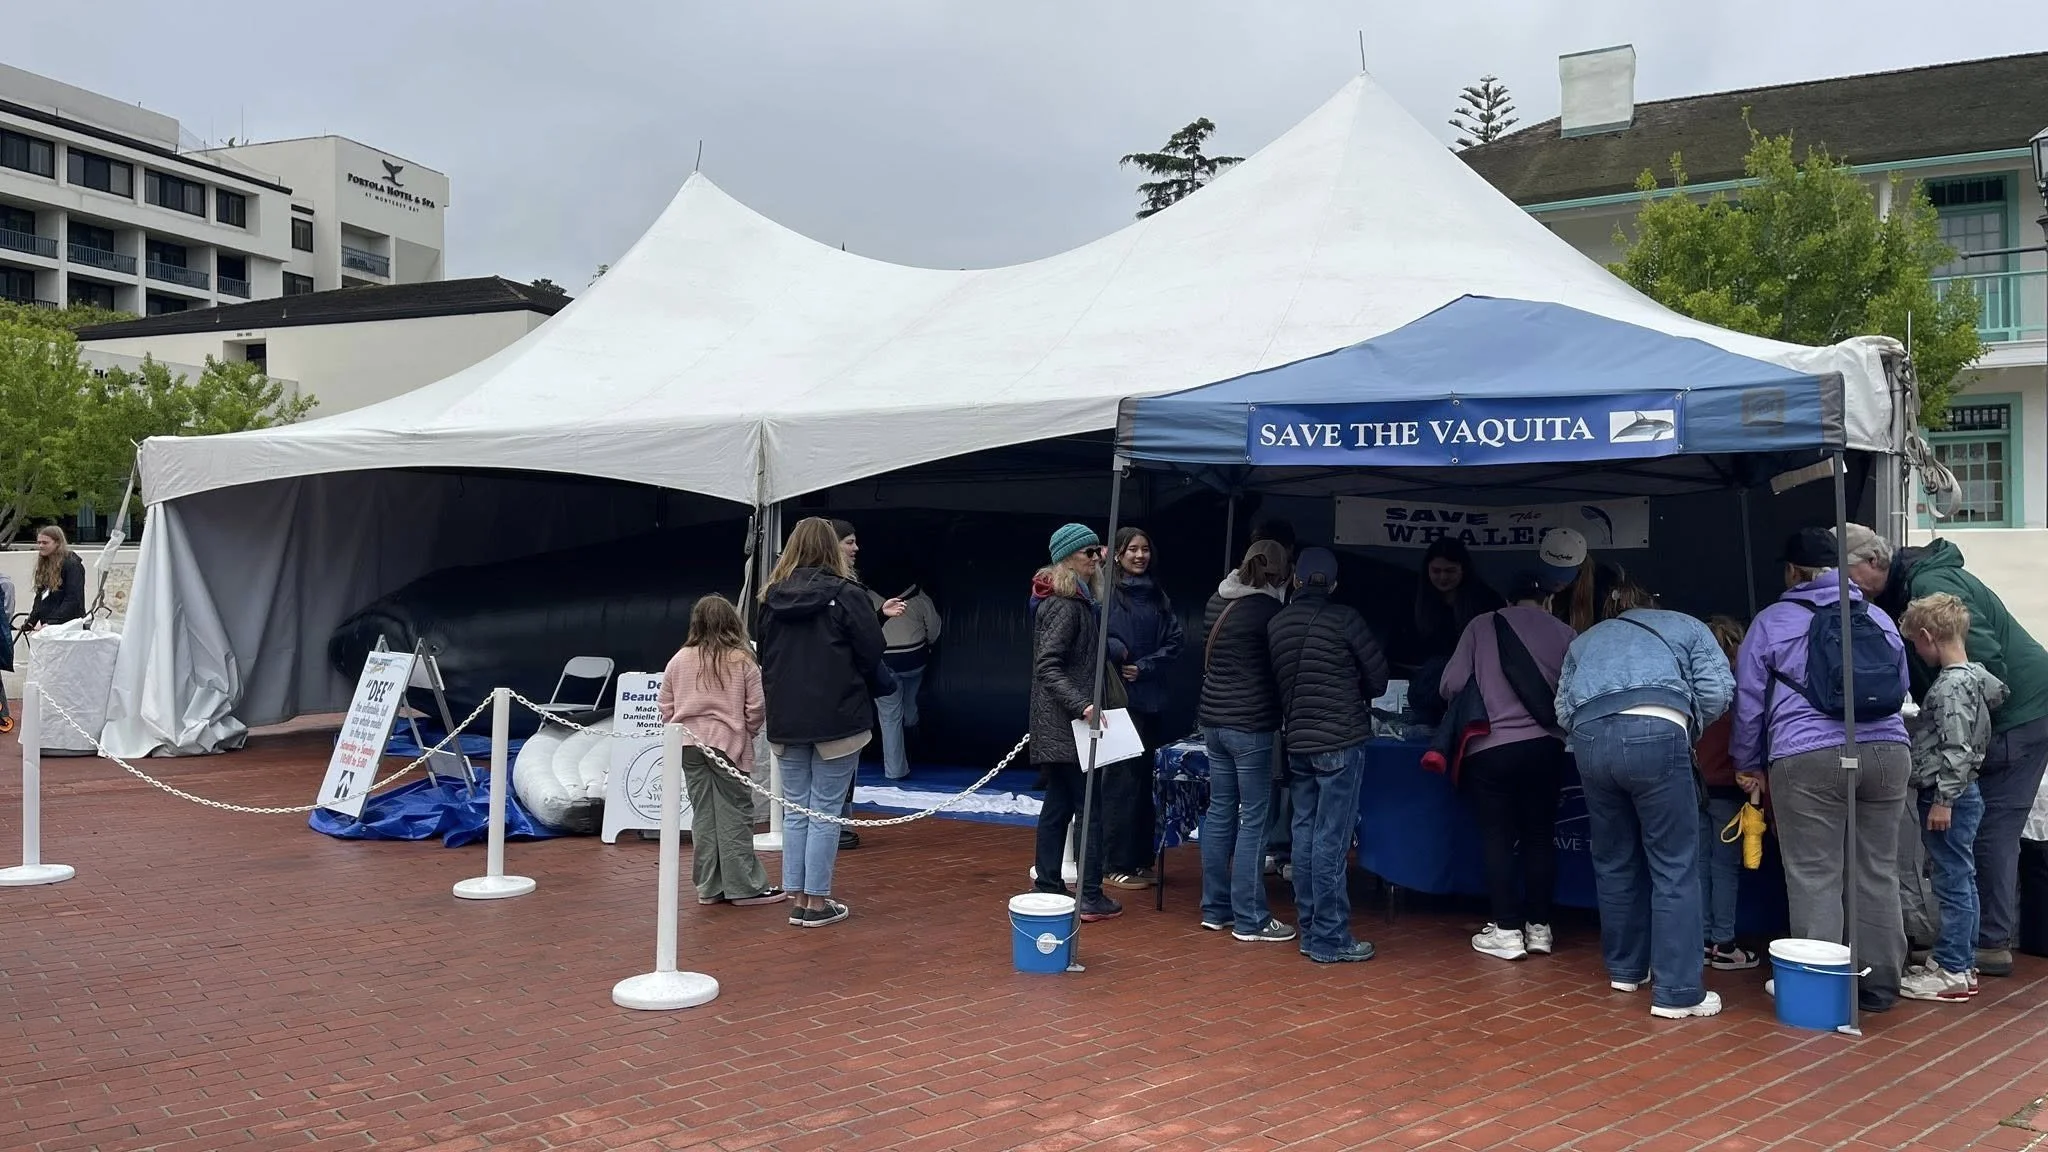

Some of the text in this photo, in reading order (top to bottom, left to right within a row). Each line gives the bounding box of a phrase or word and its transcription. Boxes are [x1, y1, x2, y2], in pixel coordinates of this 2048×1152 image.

[348, 172, 435, 208] PORTOLA HOTEL & SPA
[1260, 416, 1595, 448] SAVE THE VAQUITA
[1385, 507, 1542, 525] SAVE The
[647, 680, 662, 690] De
[622, 692, 658, 702] Beaut
[1552, 836, 1582, 851] AVE
